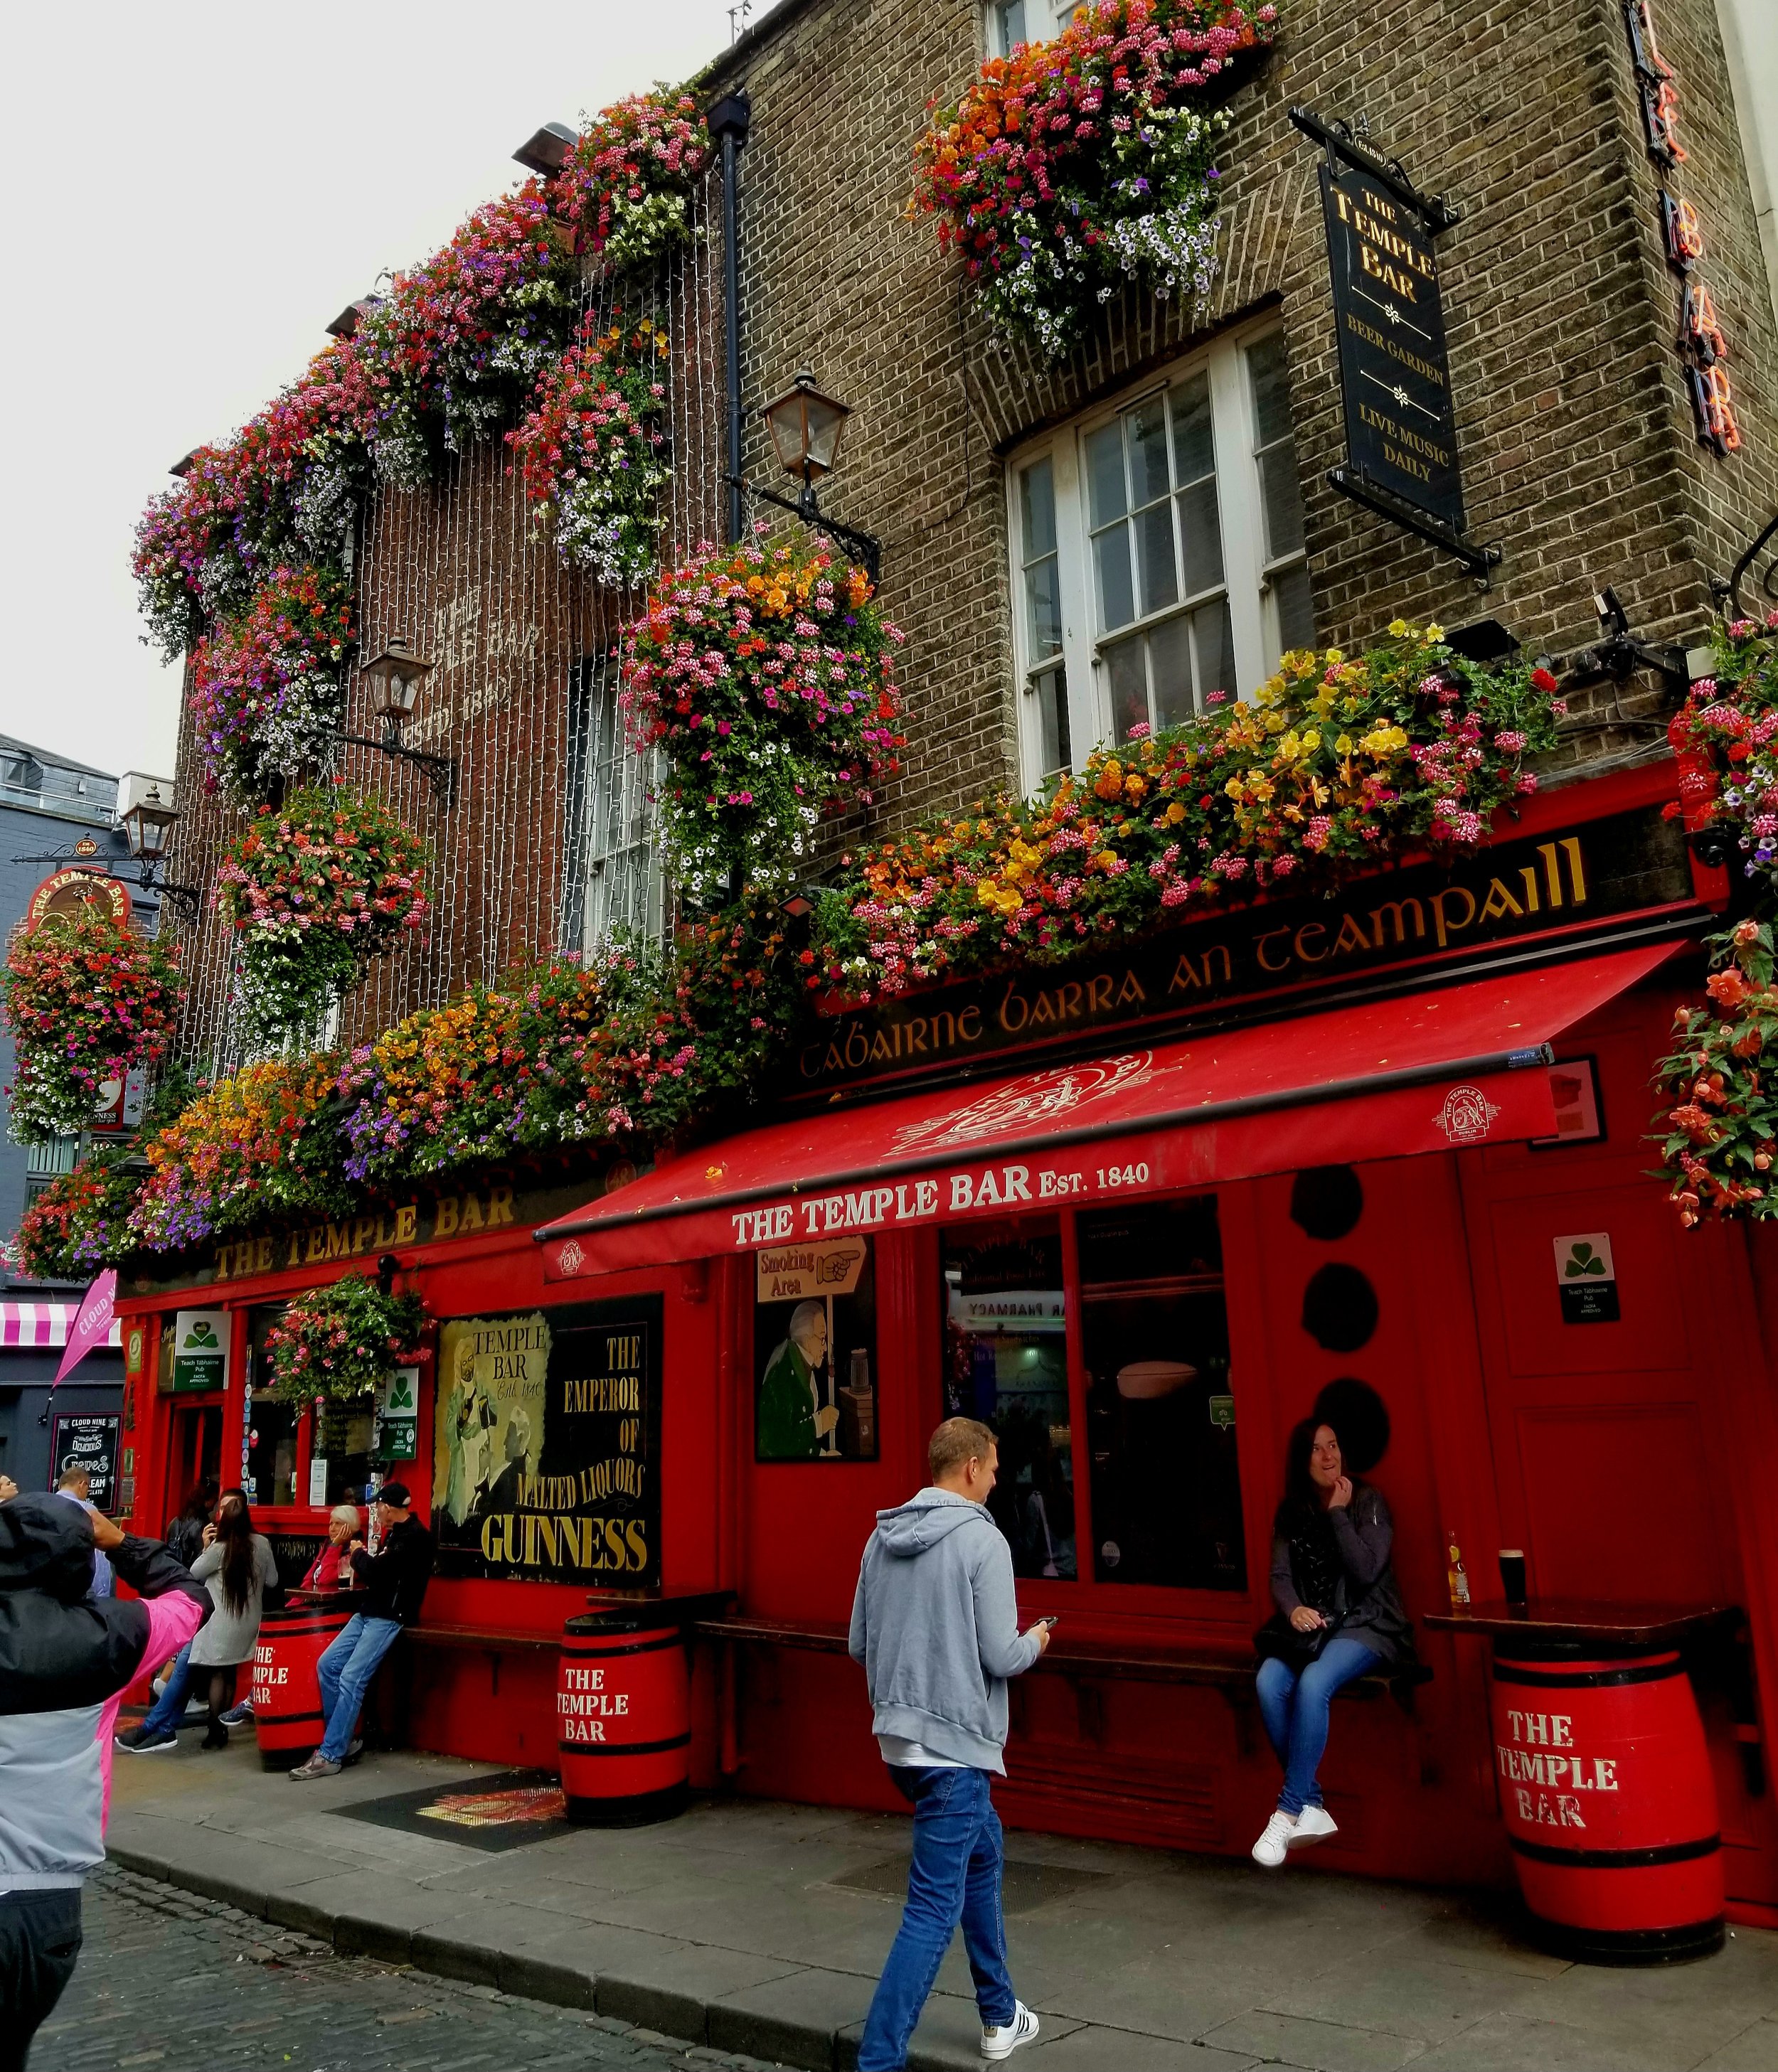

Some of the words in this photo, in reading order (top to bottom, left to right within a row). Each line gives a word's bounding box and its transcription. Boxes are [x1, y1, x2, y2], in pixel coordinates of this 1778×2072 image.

[1361, 188, 1398, 225] THE
[1329, 184, 1435, 281] TEMPLE
[1359, 240, 1417, 304] BAR
[1346, 312, 1386, 352] BEER
[1387, 340, 1444, 387] GARDEN
[1359, 402, 1398, 439] LIVE
[1399, 426, 1449, 468] MUSIC
[1383, 442, 1432, 484] DAILY
[31, 888, 52, 919] THE
[107, 885, 125, 918] BAR
[1449, 1089, 1476, 1101] TEMPLE
[1476, 1094, 1484, 1111] BAR
[731, 1205, 794, 1245] THE
[801, 1180, 938, 1233] TEMPLE
[948, 1165, 1033, 1212] BAR
[1095, 1162, 1149, 1189] 1840
[215, 1235, 275, 1278] THE
[287, 1205, 418, 1266] TEMPLE
[433, 1184, 515, 1237] BAR
[760, 1249, 815, 1274] Smoking
[771, 1275, 802, 1296] Area
[79, 1298, 109, 1335] CLOUD
[472, 1325, 547, 1355] TEMPLE
[606, 1335, 641, 1372] THE
[492, 1354, 528, 1381] BAR
[563, 1377, 640, 1414] EMPEROR
[72, 1419, 91, 1427] CLOUD
[619, 1418, 640, 1453] OF
[515, 1473, 577, 1510] MALTED
[578, 1457, 646, 1505] LIQUORS
[481, 1514, 648, 1572] GUINNESS
[565, 1668, 605, 1689] THE
[557, 1692, 629, 1715] TEMPLE
[565, 1719, 606, 1741] BAR
[1507, 1710, 1574, 1748] THE
[1496, 1745, 1619, 1790] TEMPLE
[1514, 1788, 1587, 1828] BAR
